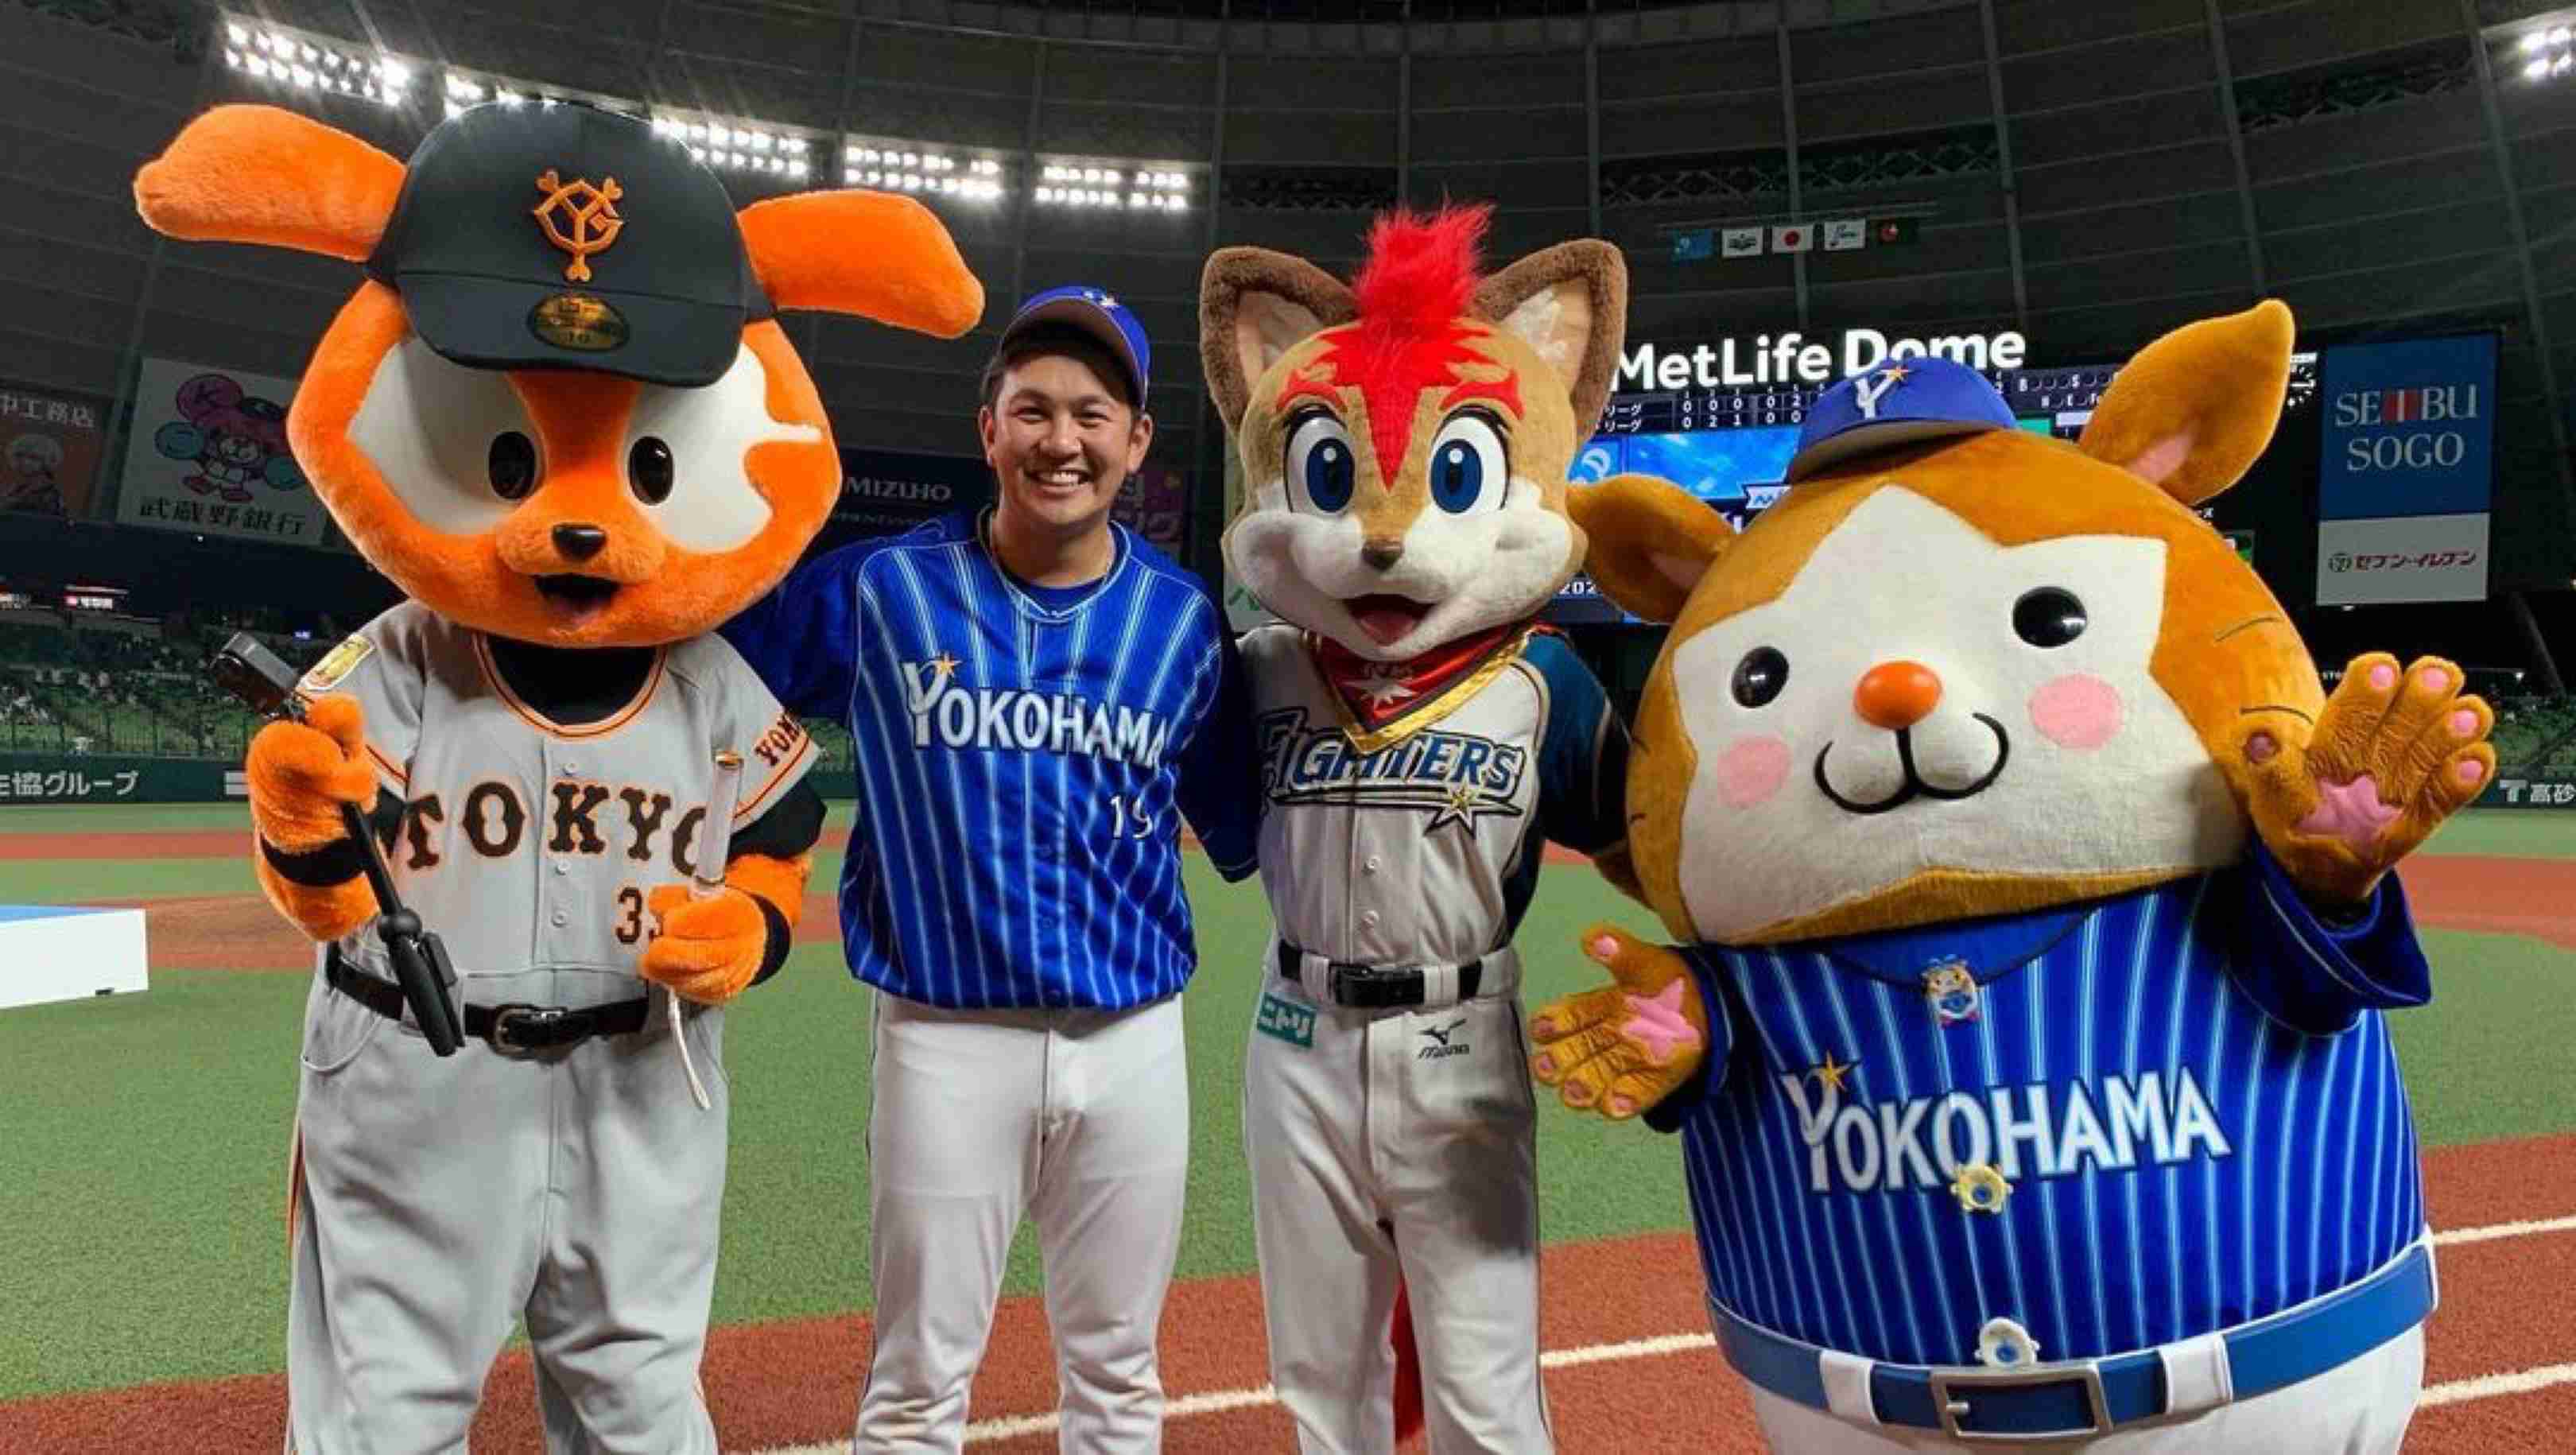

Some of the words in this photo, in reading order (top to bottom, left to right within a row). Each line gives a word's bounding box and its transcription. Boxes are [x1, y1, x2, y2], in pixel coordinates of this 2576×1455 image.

[1611, 332, 1832, 391] MetLife
[2335, 383, 2478, 427] SEIBU
[2346, 432, 2465, 471] SOGO
[844, 477, 953, 502] MIZUHO
[903, 661, 1169, 769] YOKOHAMA
[387, 782, 708, 877] TOKYO
[1780, 1065, 2231, 1192] YOKOHAMA
